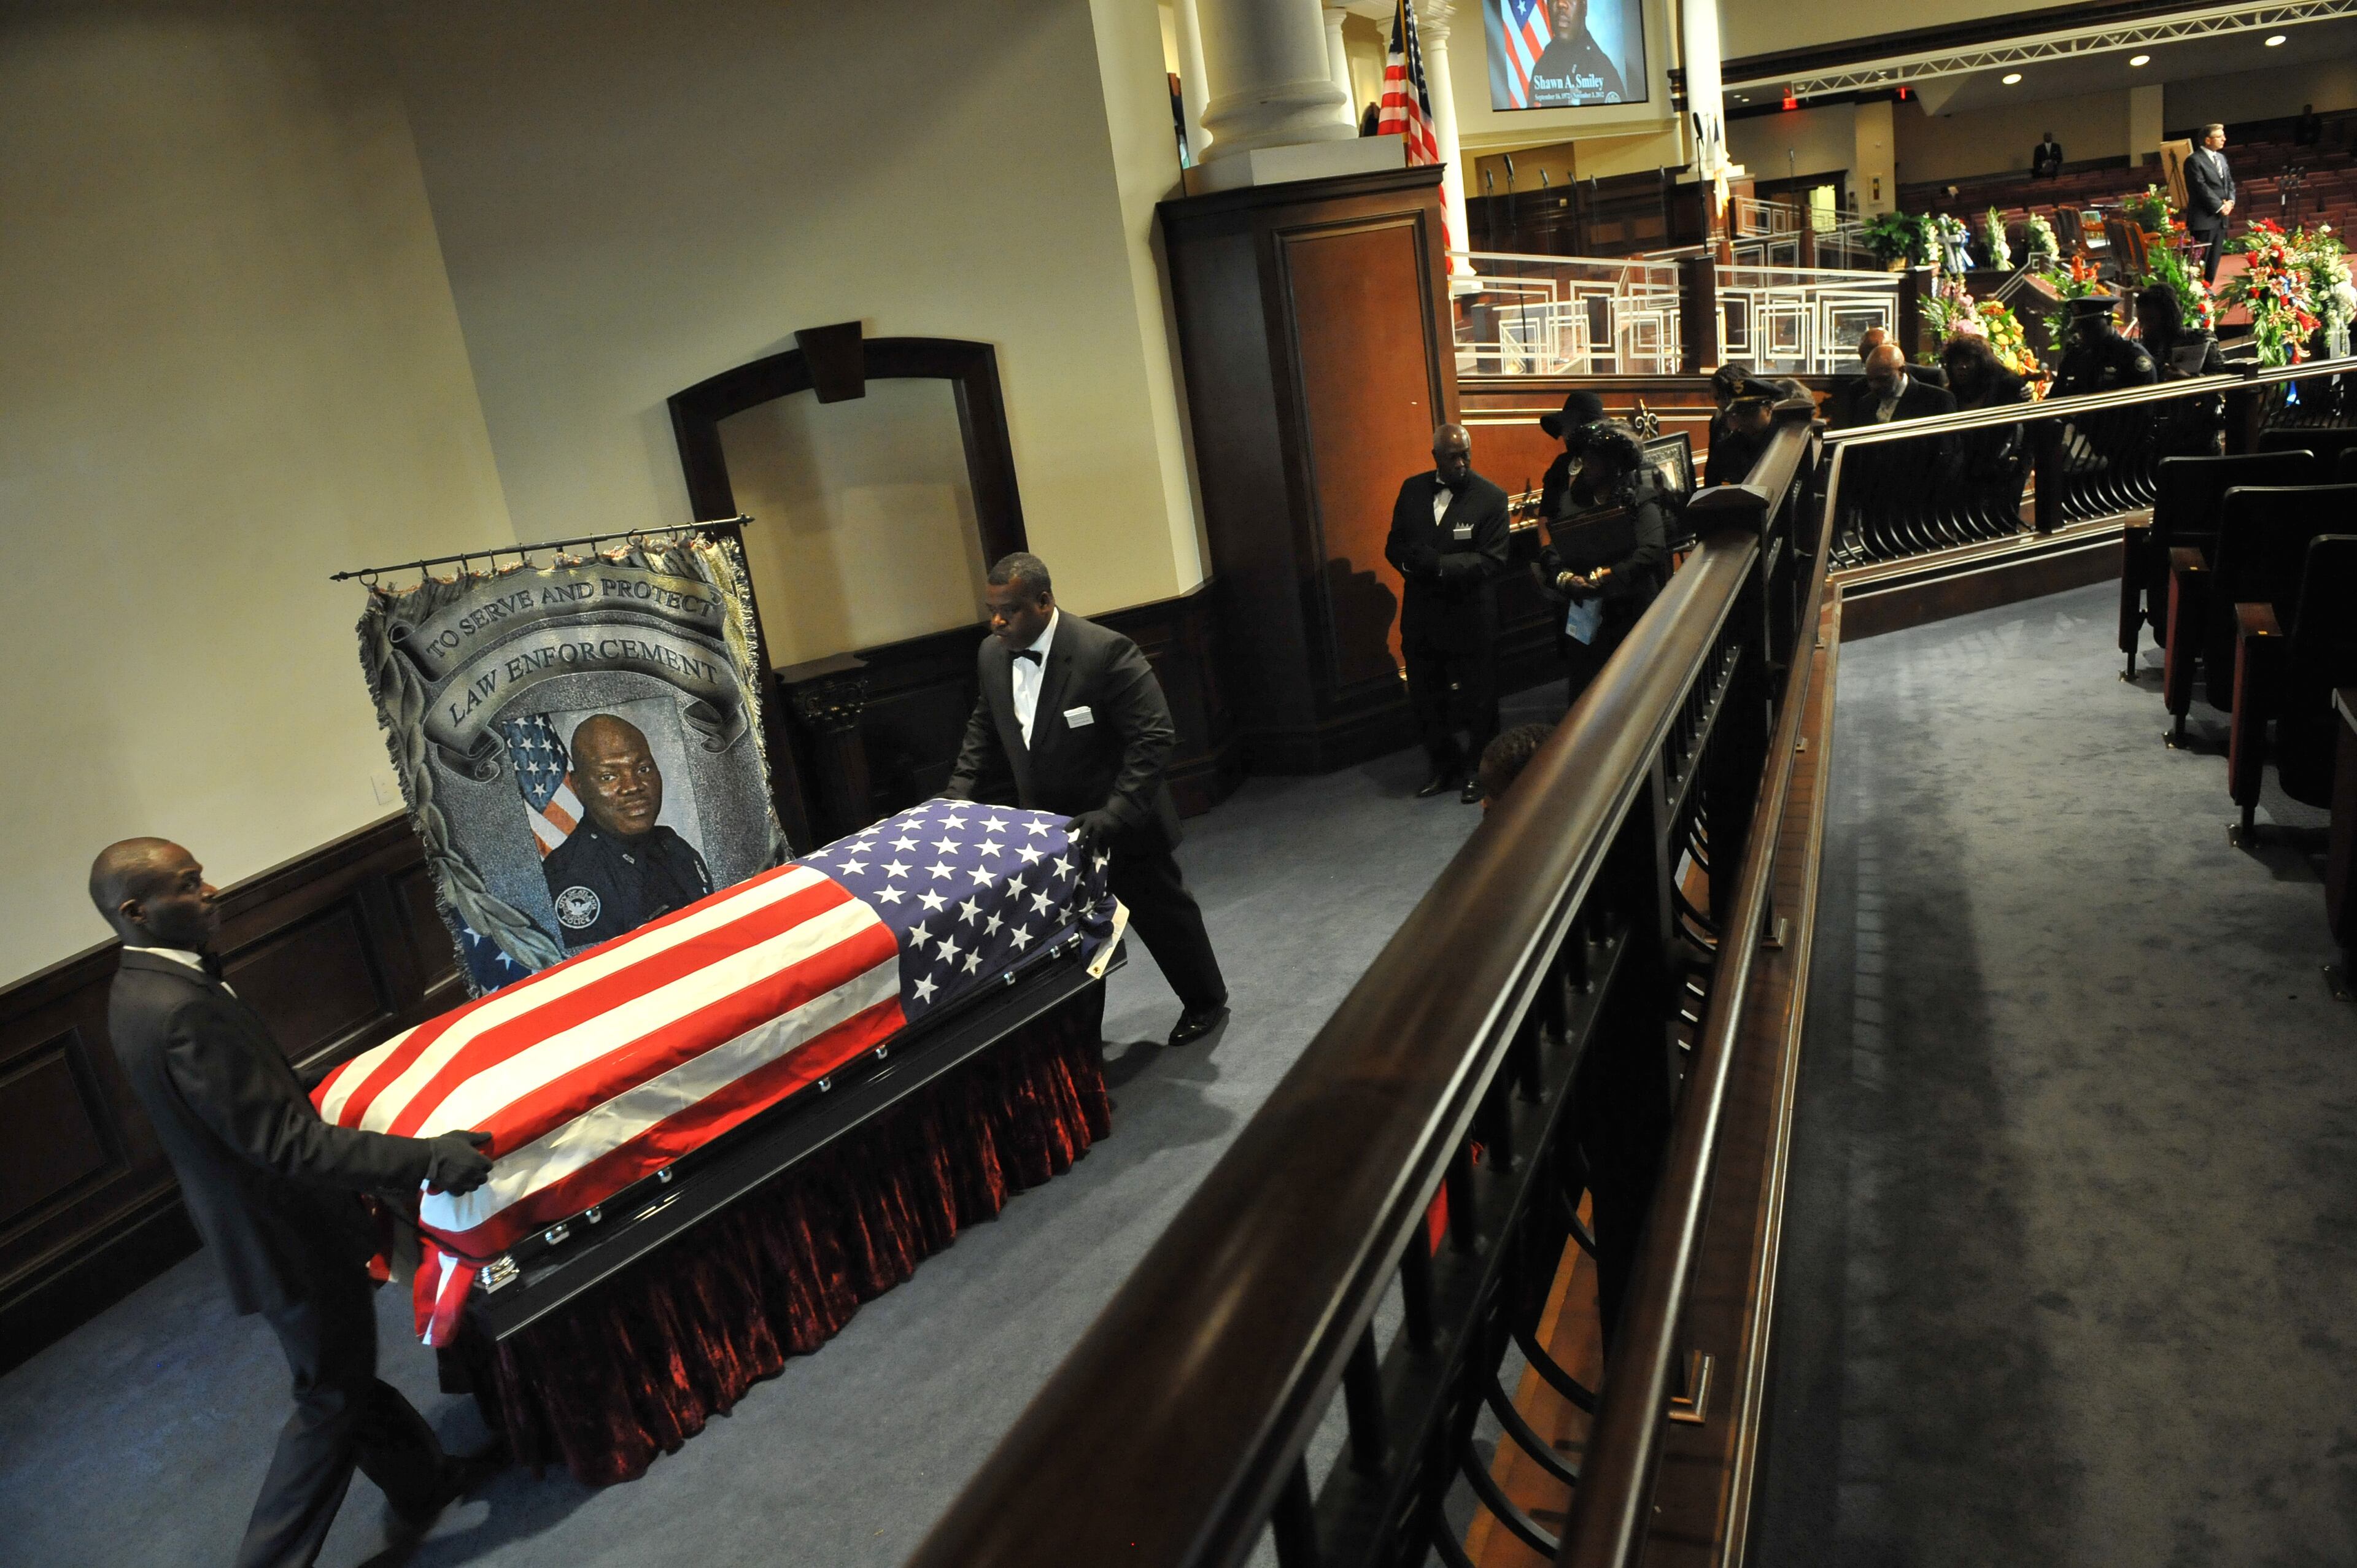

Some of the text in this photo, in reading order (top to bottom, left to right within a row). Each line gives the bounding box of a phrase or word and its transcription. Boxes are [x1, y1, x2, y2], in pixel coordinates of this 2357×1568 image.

[1534, 74, 1604, 91] Shawn A. Smiley
[426, 578, 715, 657] TO SERVE AND PROTECT
[449, 639, 718, 727] LAW ENFORCEMENT
[561, 915, 591, 925] POLICE
